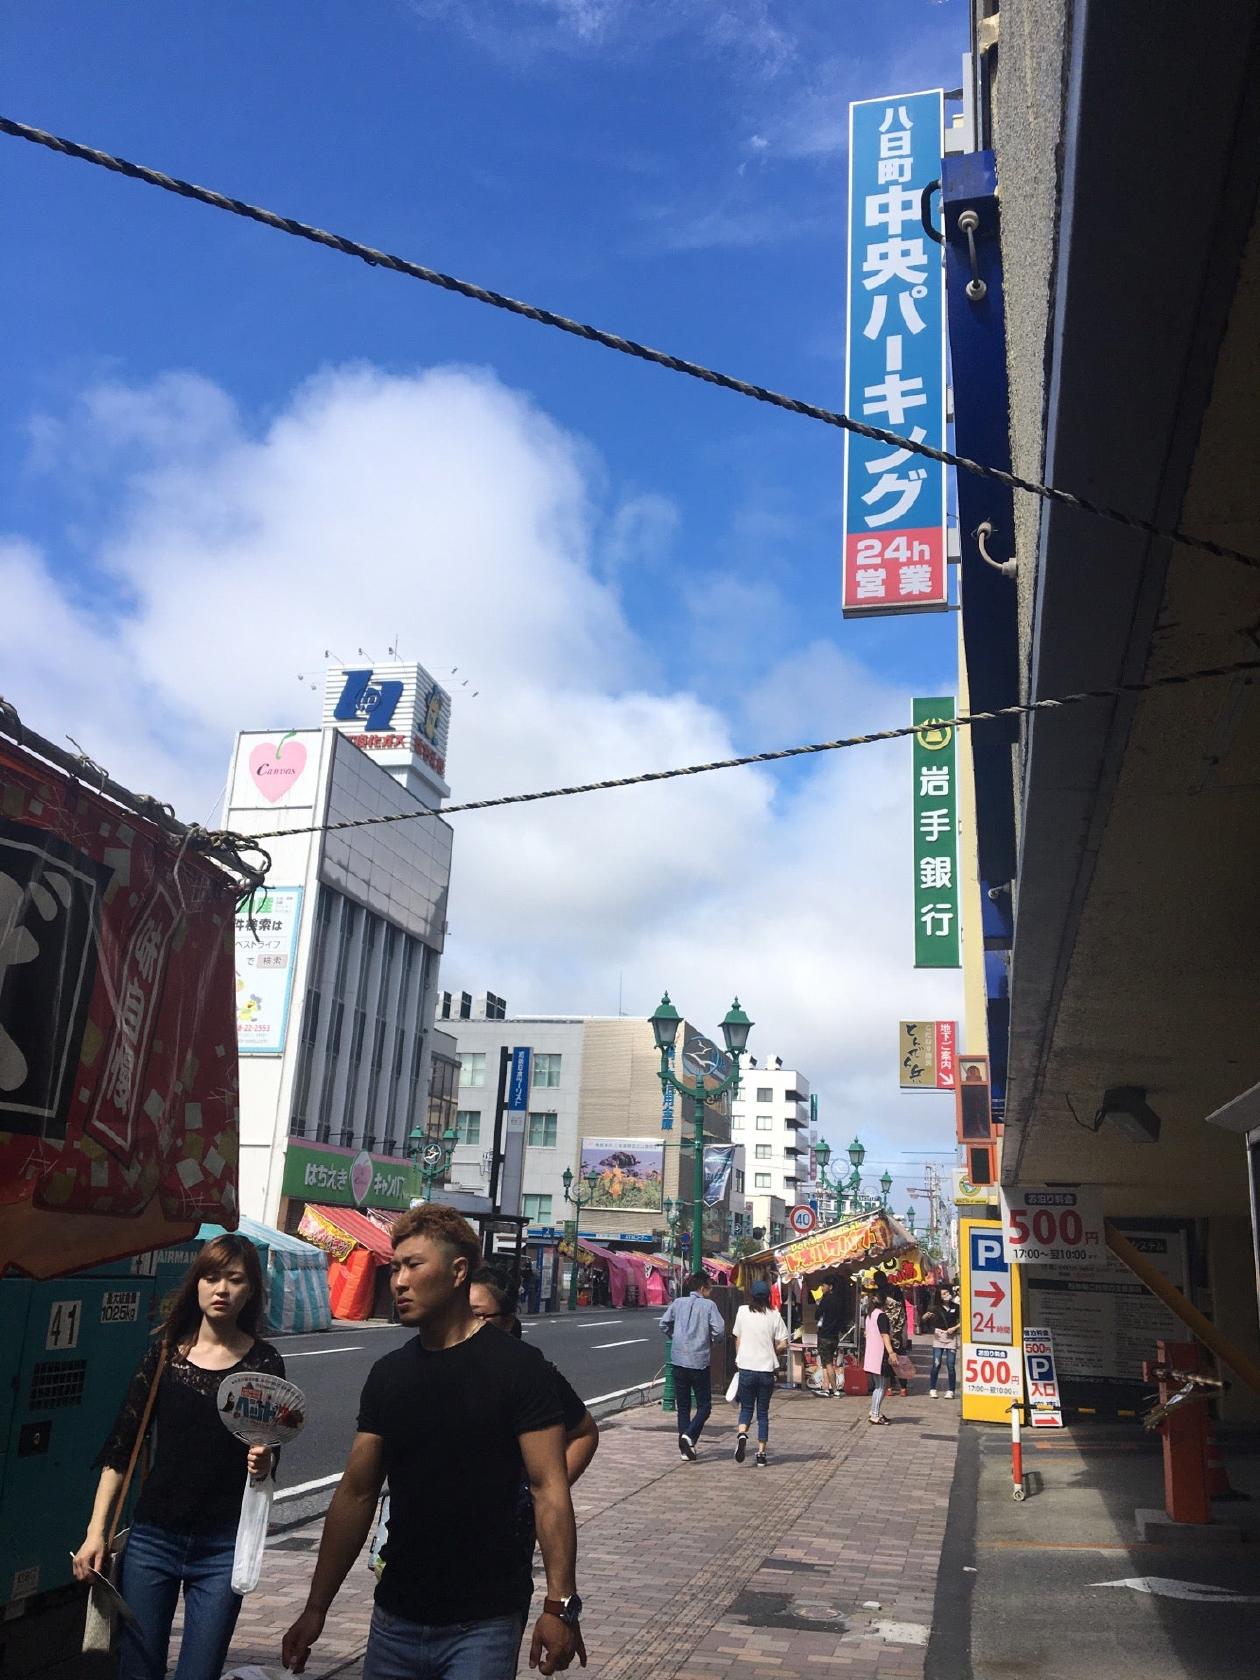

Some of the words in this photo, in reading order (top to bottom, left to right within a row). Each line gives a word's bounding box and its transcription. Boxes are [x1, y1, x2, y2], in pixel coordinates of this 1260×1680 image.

[856, 536, 931, 565] 24h
[855, 564, 933, 599] 営業
[256, 762, 297, 777] Canvas
[919, 765, 954, 937] 岩手銀行
[304, 1162, 348, 1191] はちえき
[796, 1213, 810, 1226] 40
[1008, 1208, 1099, 1246] 500円
[977, 1239, 1002, 1267] P
[52, 1303, 79, 1346] 41
[965, 1359, 1020, 1385] 500円
[1031, 1357, 1050, 1379] P
[1031, 1382, 1056, 1397] 入口
